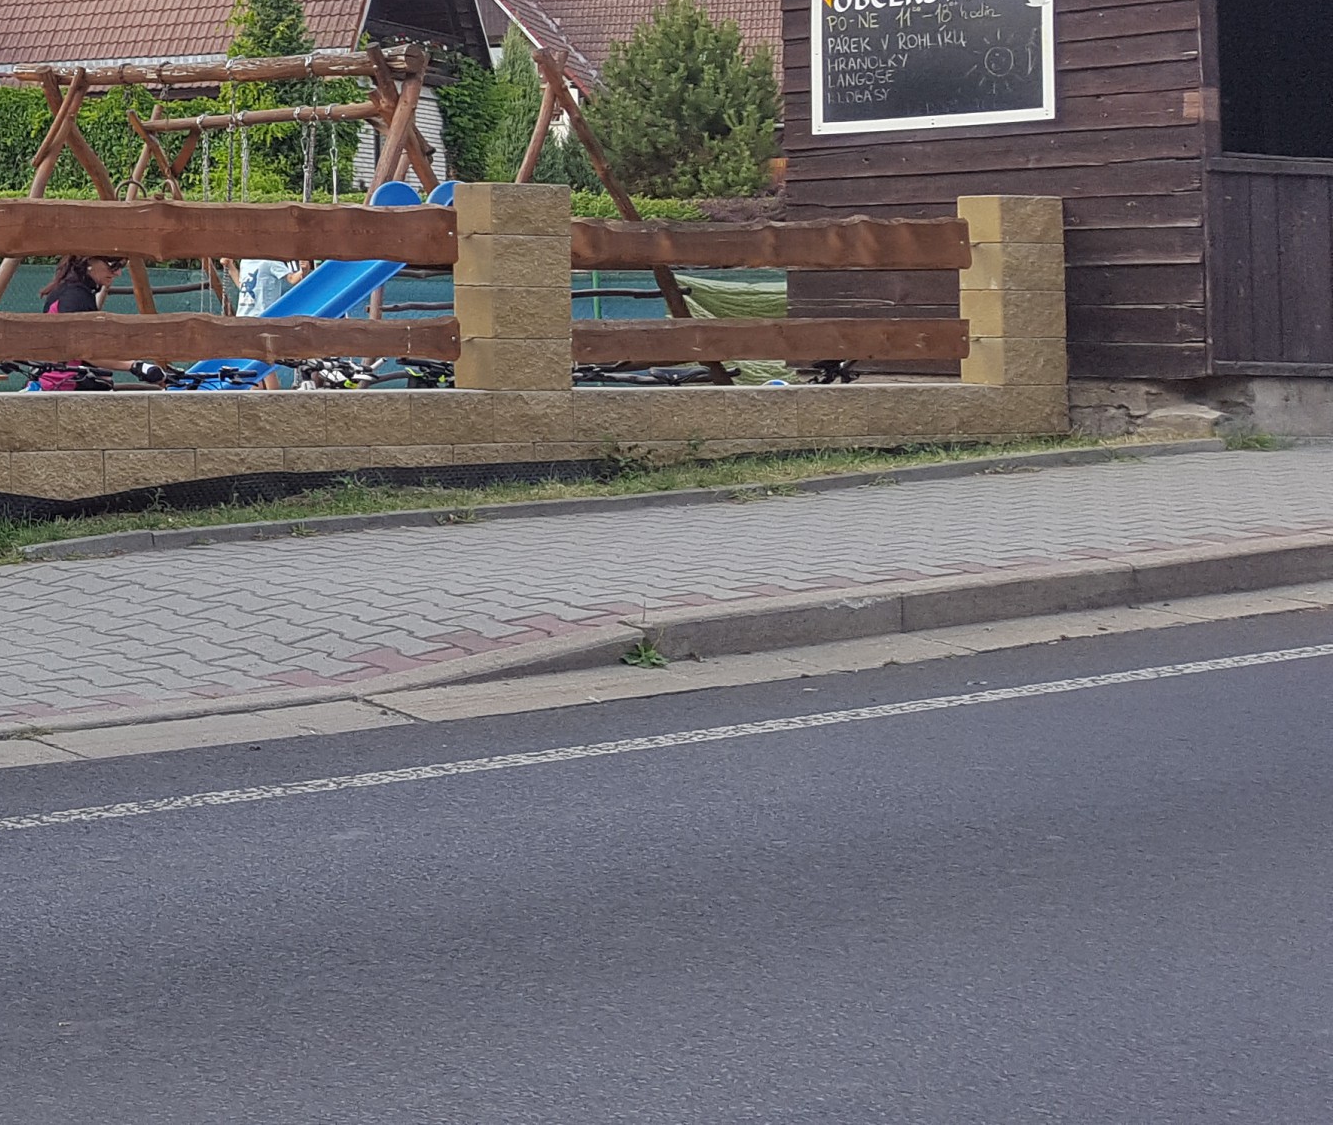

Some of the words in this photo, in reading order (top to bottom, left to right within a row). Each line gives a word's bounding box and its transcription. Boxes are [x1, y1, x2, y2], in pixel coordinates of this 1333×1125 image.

[960, 3, 1001, 20] hodin
[828, 35, 872, 54] PÁREK
[882, 34, 889, 50] V
[897, 25, 967, 49] ROHLÍKU
[827, 53, 908, 73] HRANOLKY
